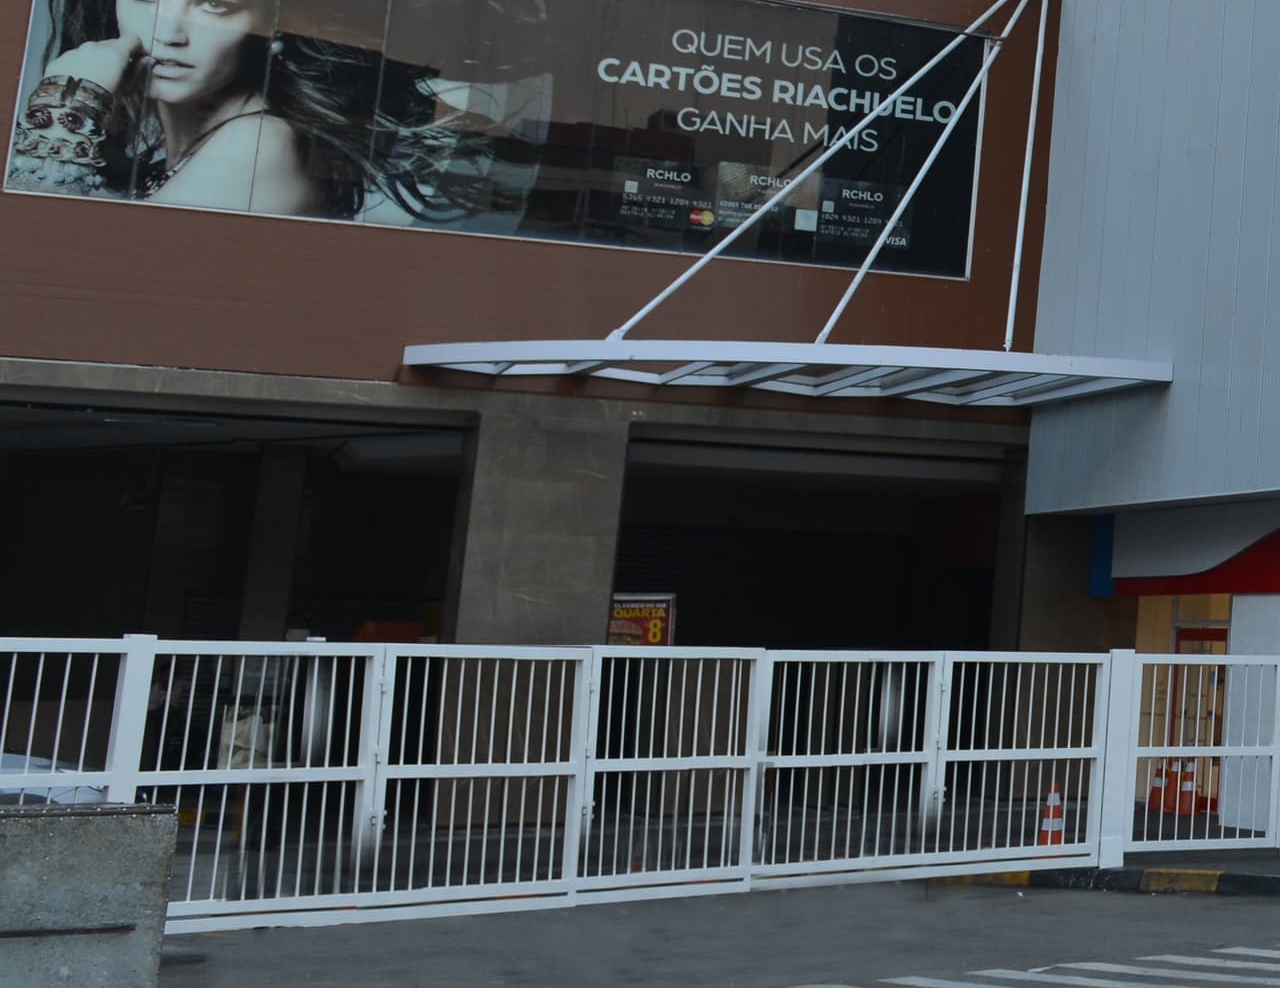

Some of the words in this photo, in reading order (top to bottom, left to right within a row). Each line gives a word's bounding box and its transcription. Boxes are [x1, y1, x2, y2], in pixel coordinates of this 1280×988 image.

[671, 28, 773, 64] QUEM
[781, 43, 846, 75] USA
[854, 53, 898, 81] OS
[597, 57, 763, 101] CARTÕES
[772, 79, 958, 125] RIACHUELO
[677, 106, 795, 144] GANHA
[803, 121, 879, 152] MAIS
[646, 168, 692, 183] RCHLO
[842, 189, 884, 202] RCHLO
[884, 235, 908, 246] VISA
[613, 608, 666, 619] QUARTA
